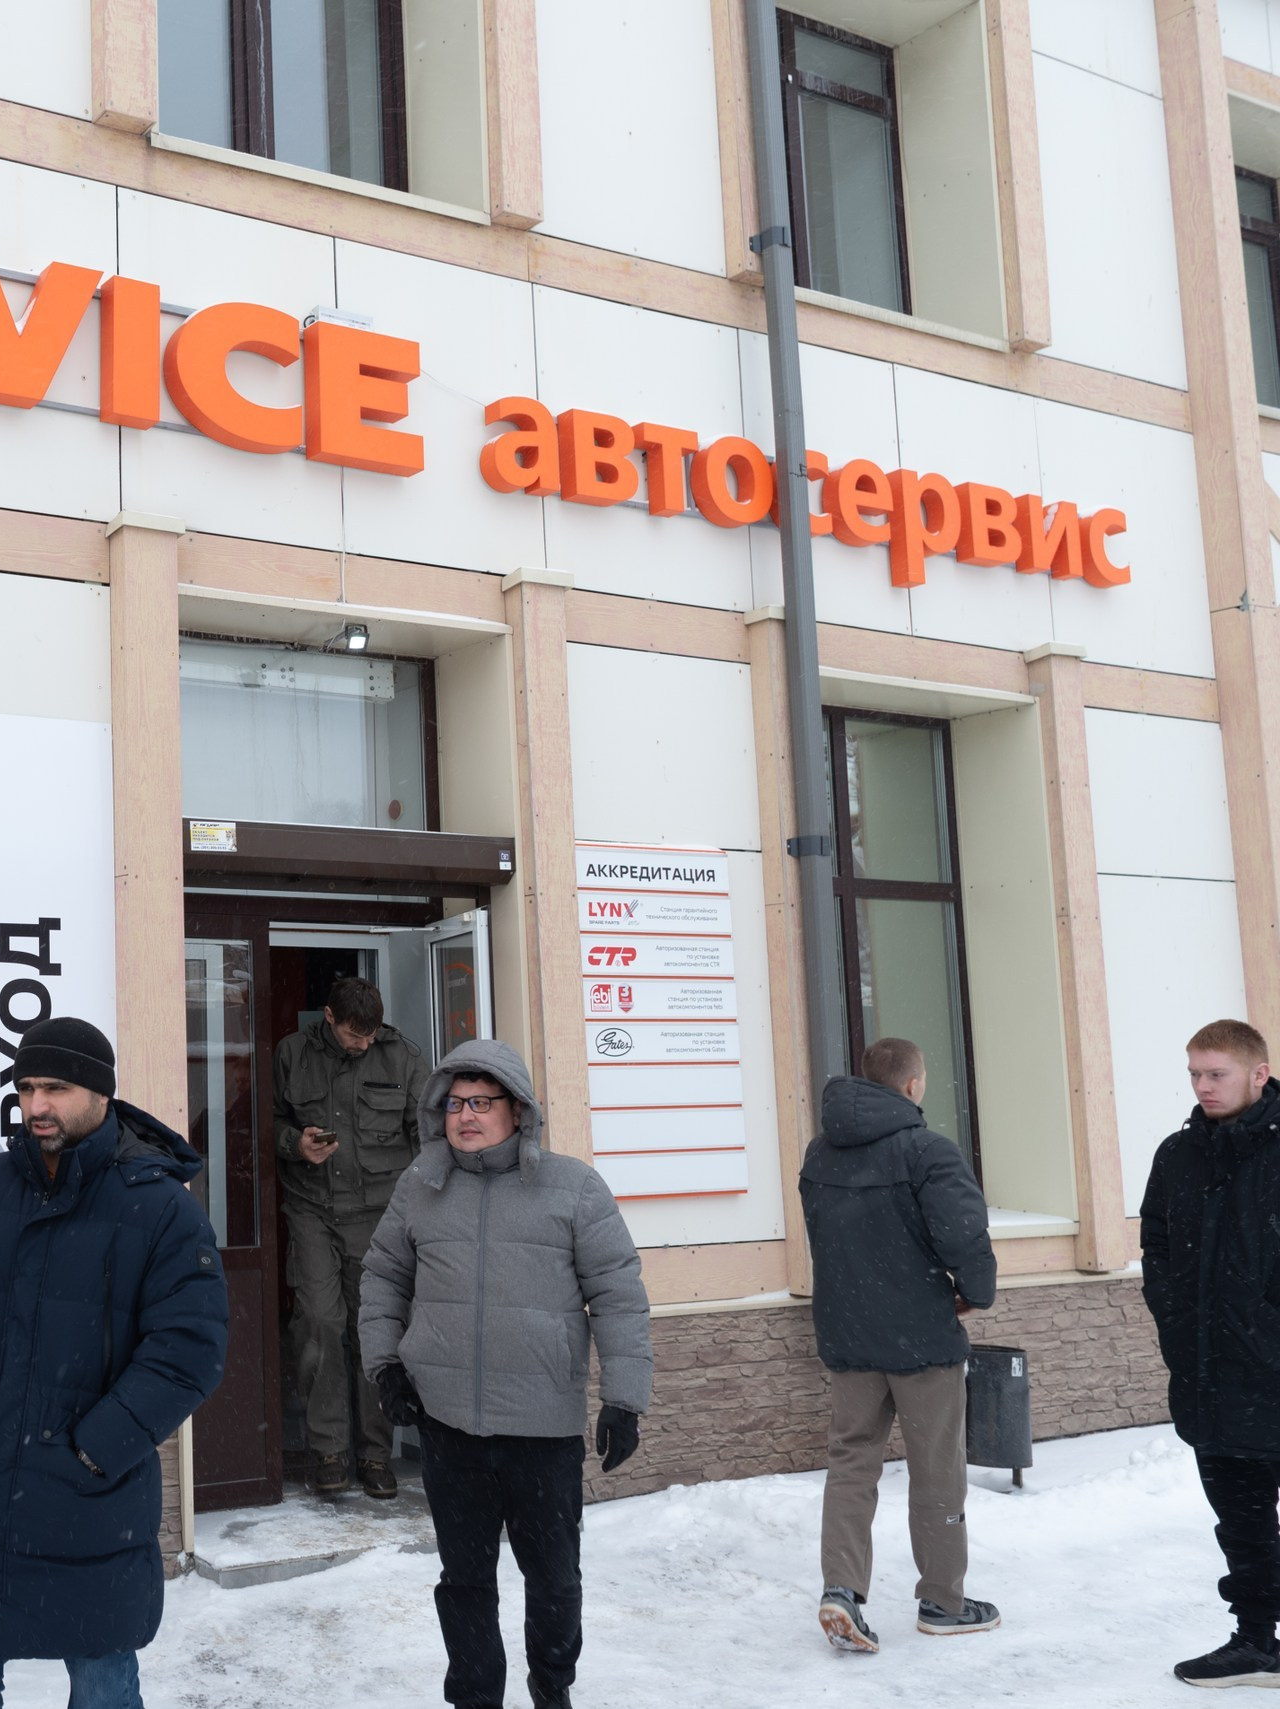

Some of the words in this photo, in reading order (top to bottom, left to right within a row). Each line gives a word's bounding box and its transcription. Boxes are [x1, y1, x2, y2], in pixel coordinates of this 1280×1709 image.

[586, 863, 716, 884] АККРЕДИТАЦИЯ
[588, 899, 638, 919] LYNX
[587, 946, 637, 966] CTR
[596, 1031, 632, 1054] Gates
